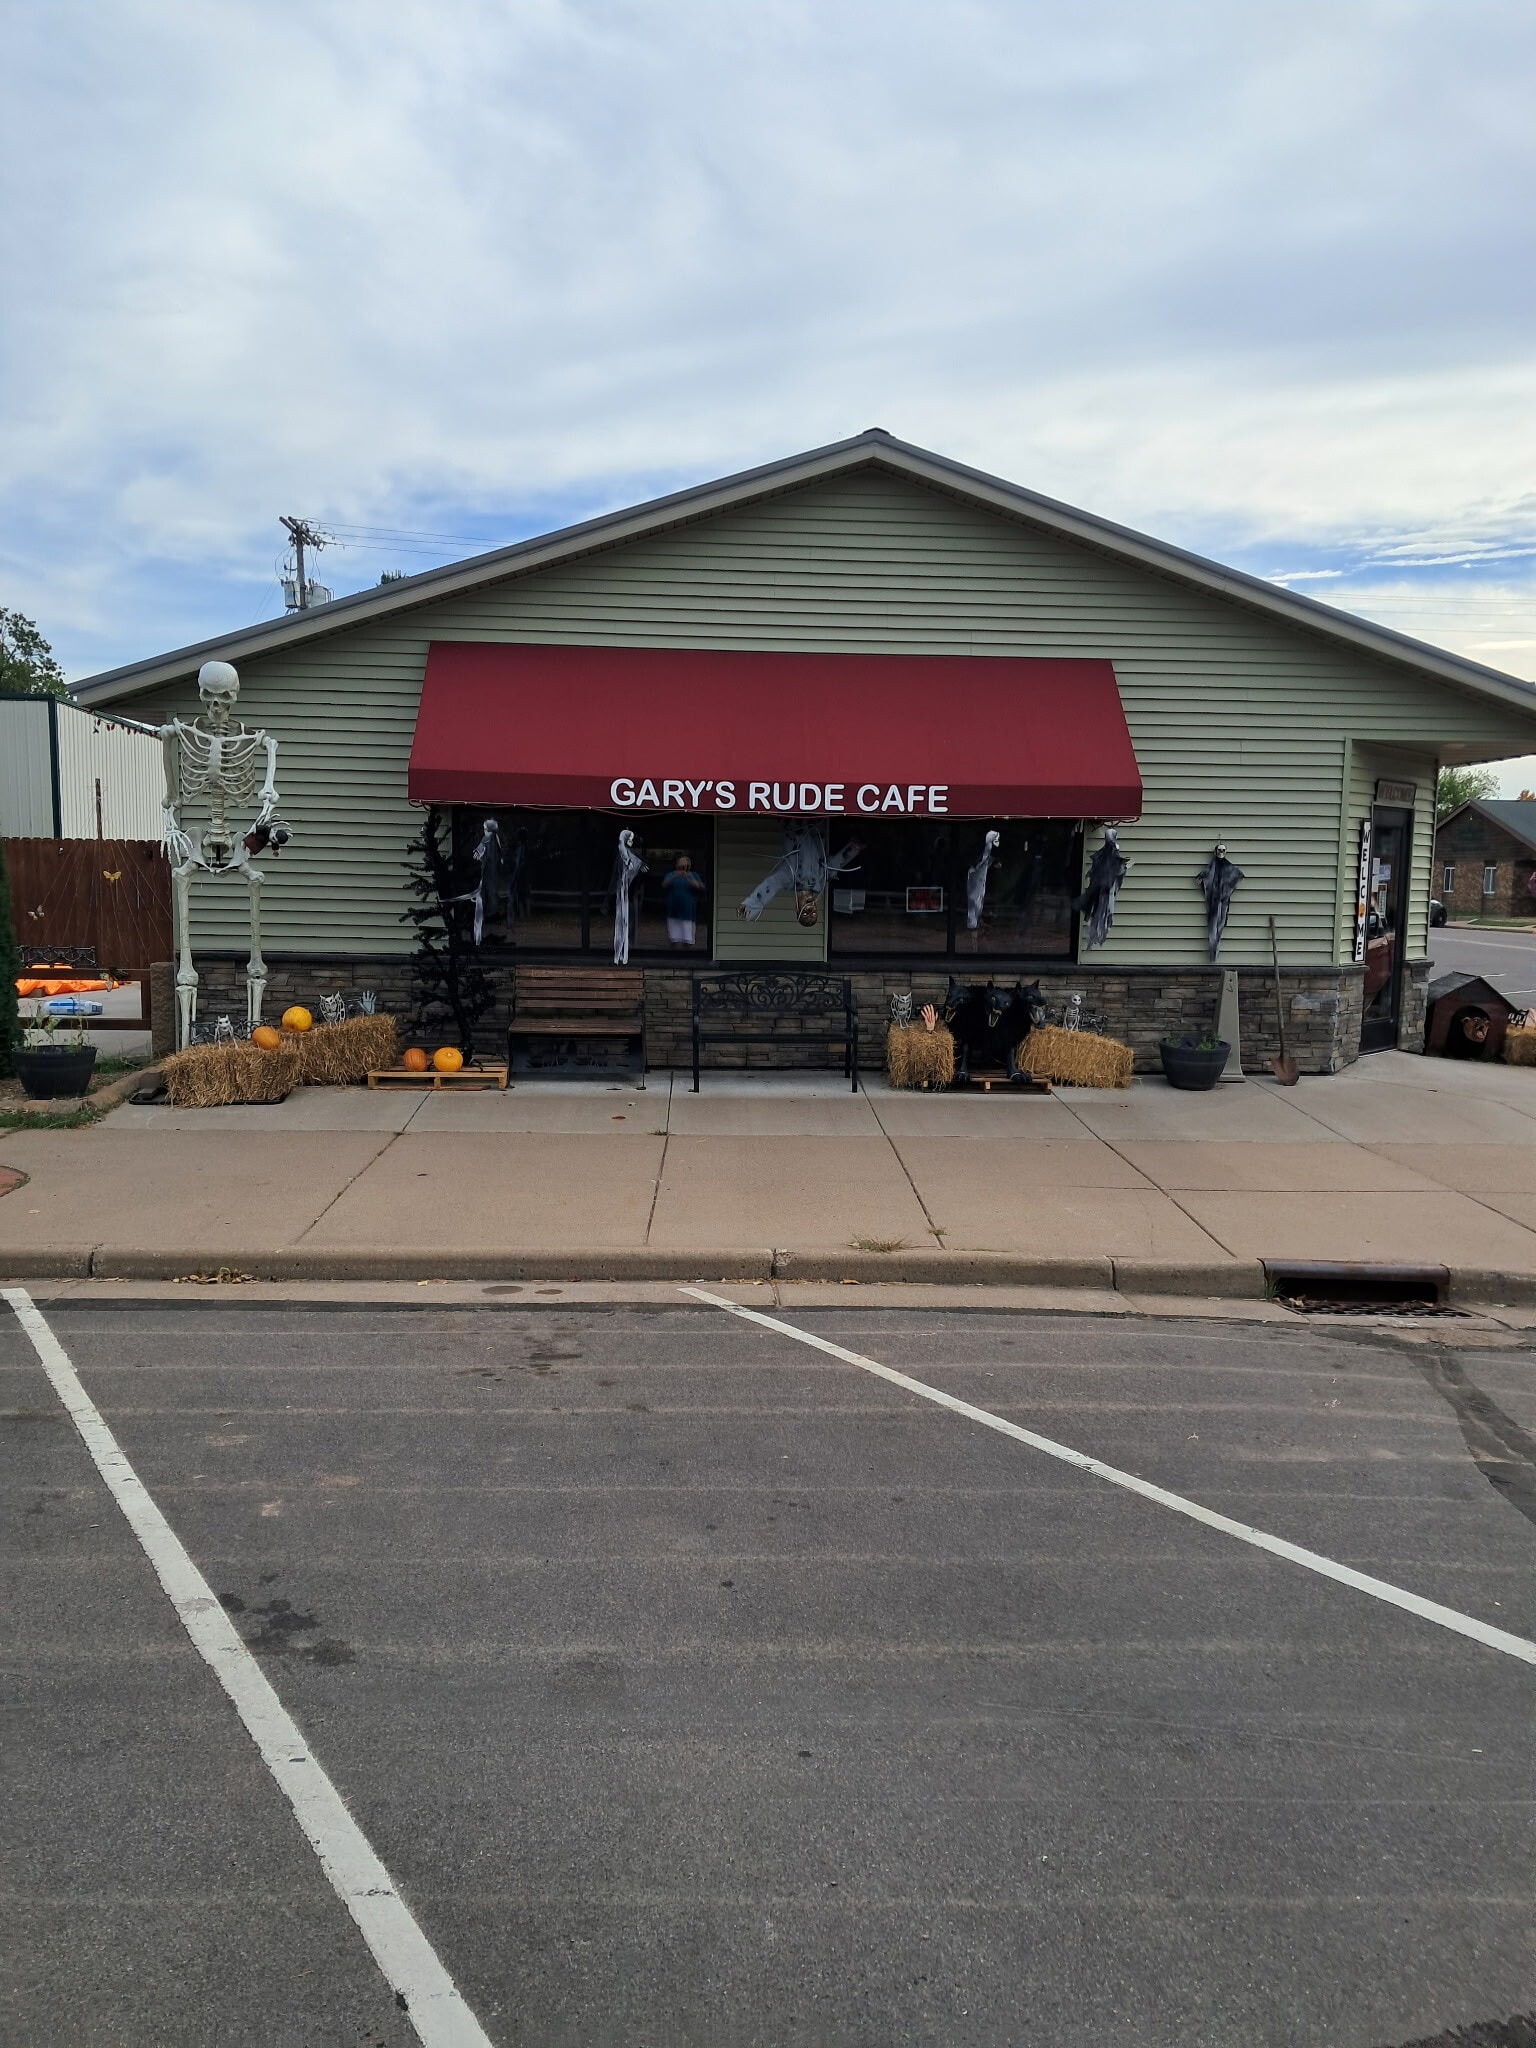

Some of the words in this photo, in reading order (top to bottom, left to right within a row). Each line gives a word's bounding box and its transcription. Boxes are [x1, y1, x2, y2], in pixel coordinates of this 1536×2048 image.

[610, 778, 736, 809] GARY'S
[748, 782, 845, 811] RUDE
[856, 784, 949, 813] CAFE
